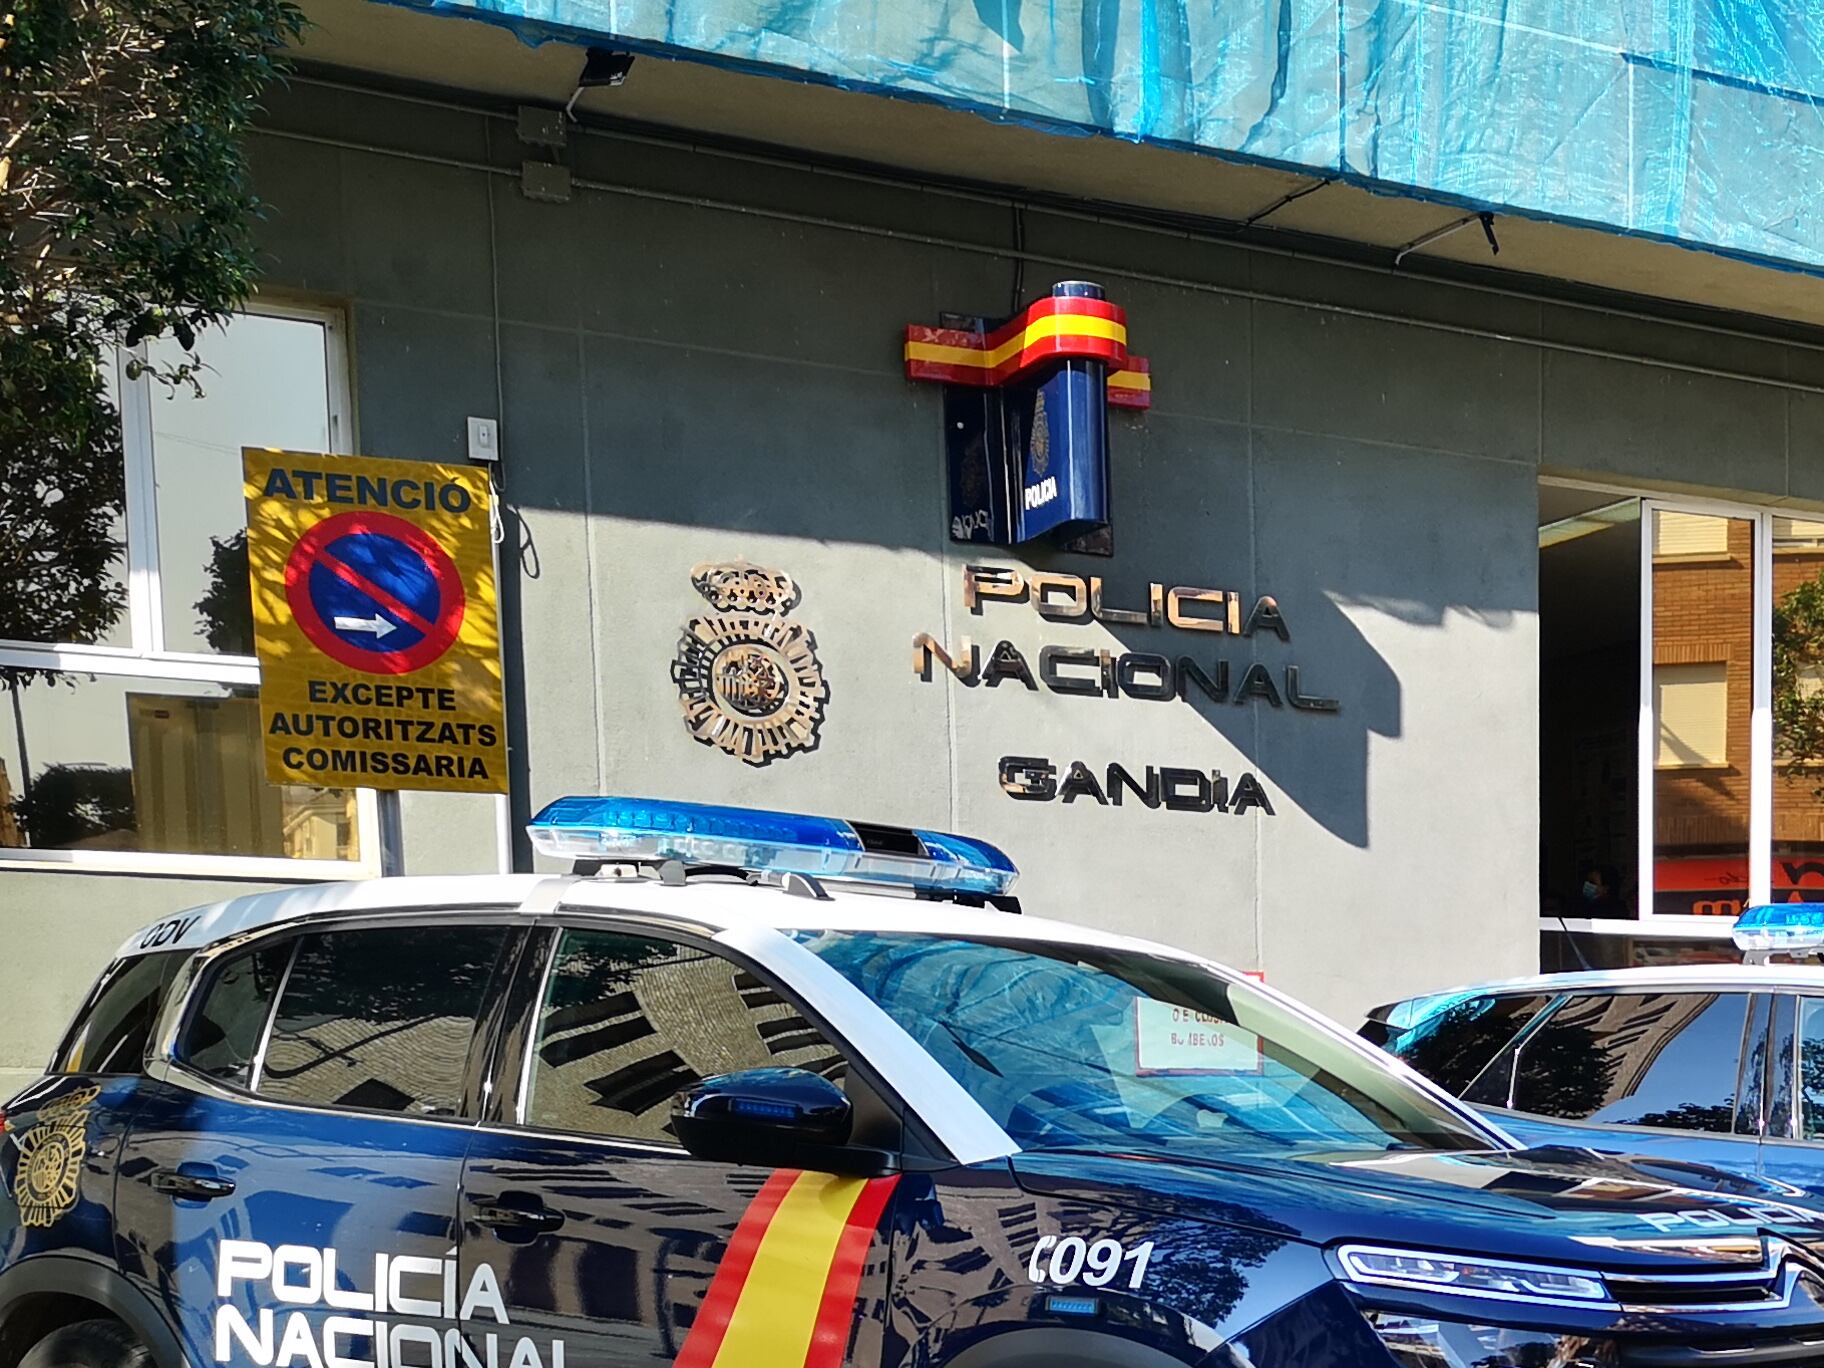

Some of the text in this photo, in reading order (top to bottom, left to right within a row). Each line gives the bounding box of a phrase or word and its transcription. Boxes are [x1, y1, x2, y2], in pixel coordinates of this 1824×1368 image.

[263, 468, 472, 513] ATENCIÓ
[962, 563, 1291, 641] POLICIA
[308, 680, 457, 711] EXCEPTE
[912, 631, 1340, 712] NACIONAL
[269, 712, 498, 747] AUTORITZATS
[282, 747, 490, 780] COMISSARIA
[998, 755, 1277, 817] GANDIA
[217, 1239, 511, 1325] POLICÍA
[1049, 1236, 1155, 1289] 091
